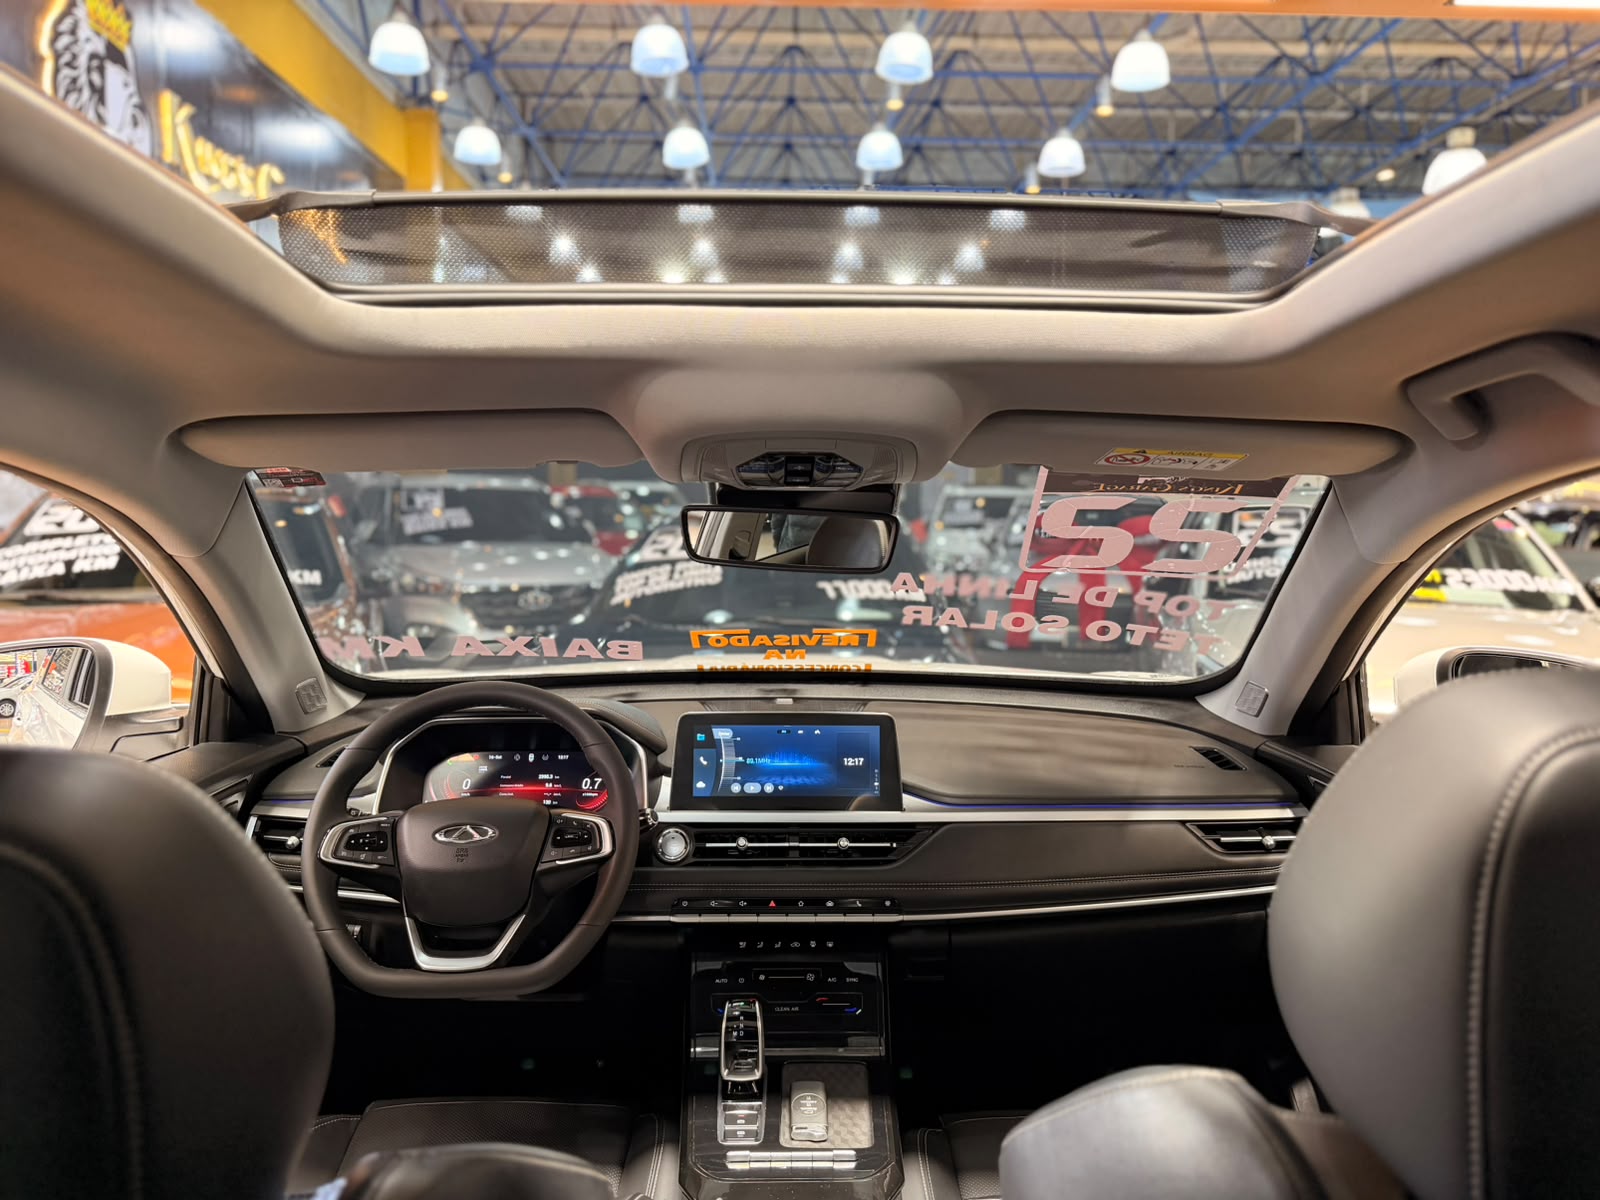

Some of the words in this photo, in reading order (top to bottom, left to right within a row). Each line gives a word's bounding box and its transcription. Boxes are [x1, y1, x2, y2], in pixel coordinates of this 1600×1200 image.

[843, 757, 865, 766] 12:17
[462, 778, 471, 790] 0
[582, 778, 602, 790] 0.7
